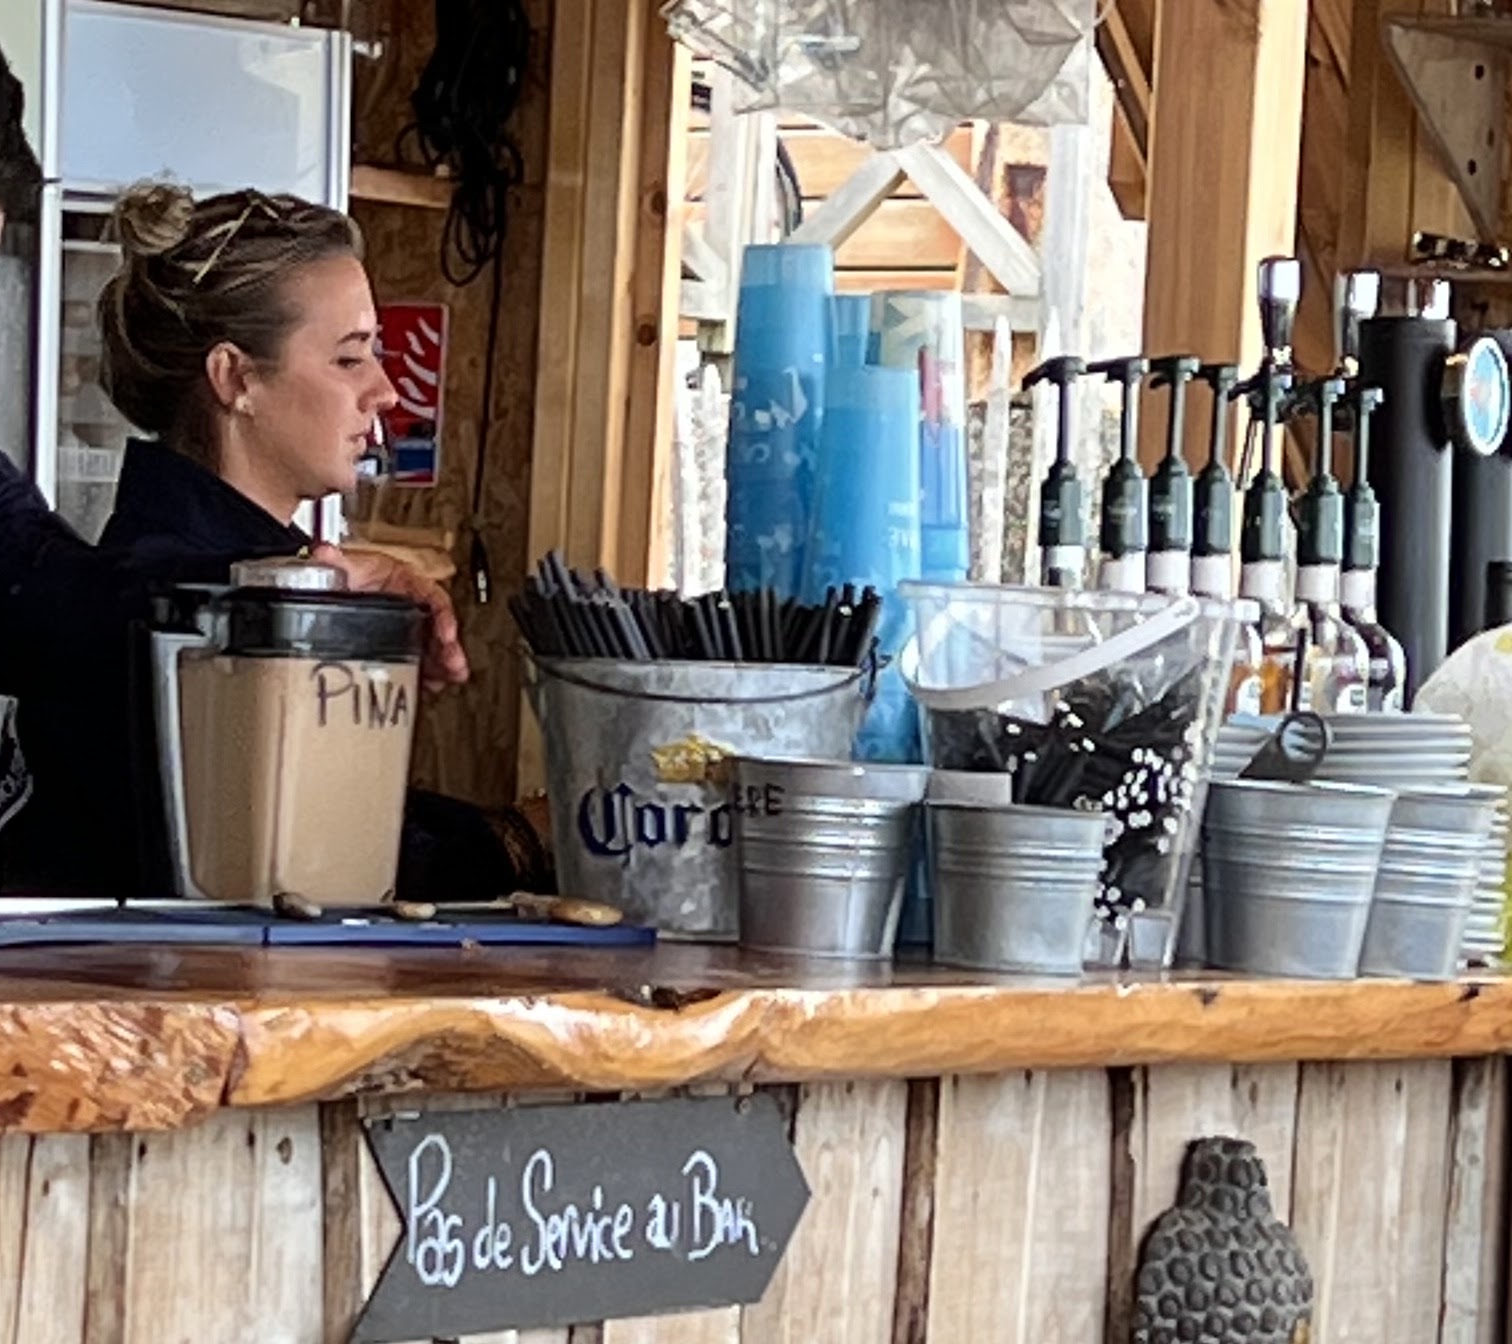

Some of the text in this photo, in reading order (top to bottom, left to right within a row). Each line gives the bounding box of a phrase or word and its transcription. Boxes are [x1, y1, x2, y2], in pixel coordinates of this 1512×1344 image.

[407, 1134, 466, 1288] Pas
[472, 1176, 515, 1270] de
[520, 1148, 634, 1276] Service
[645, 1193, 680, 1249] au
